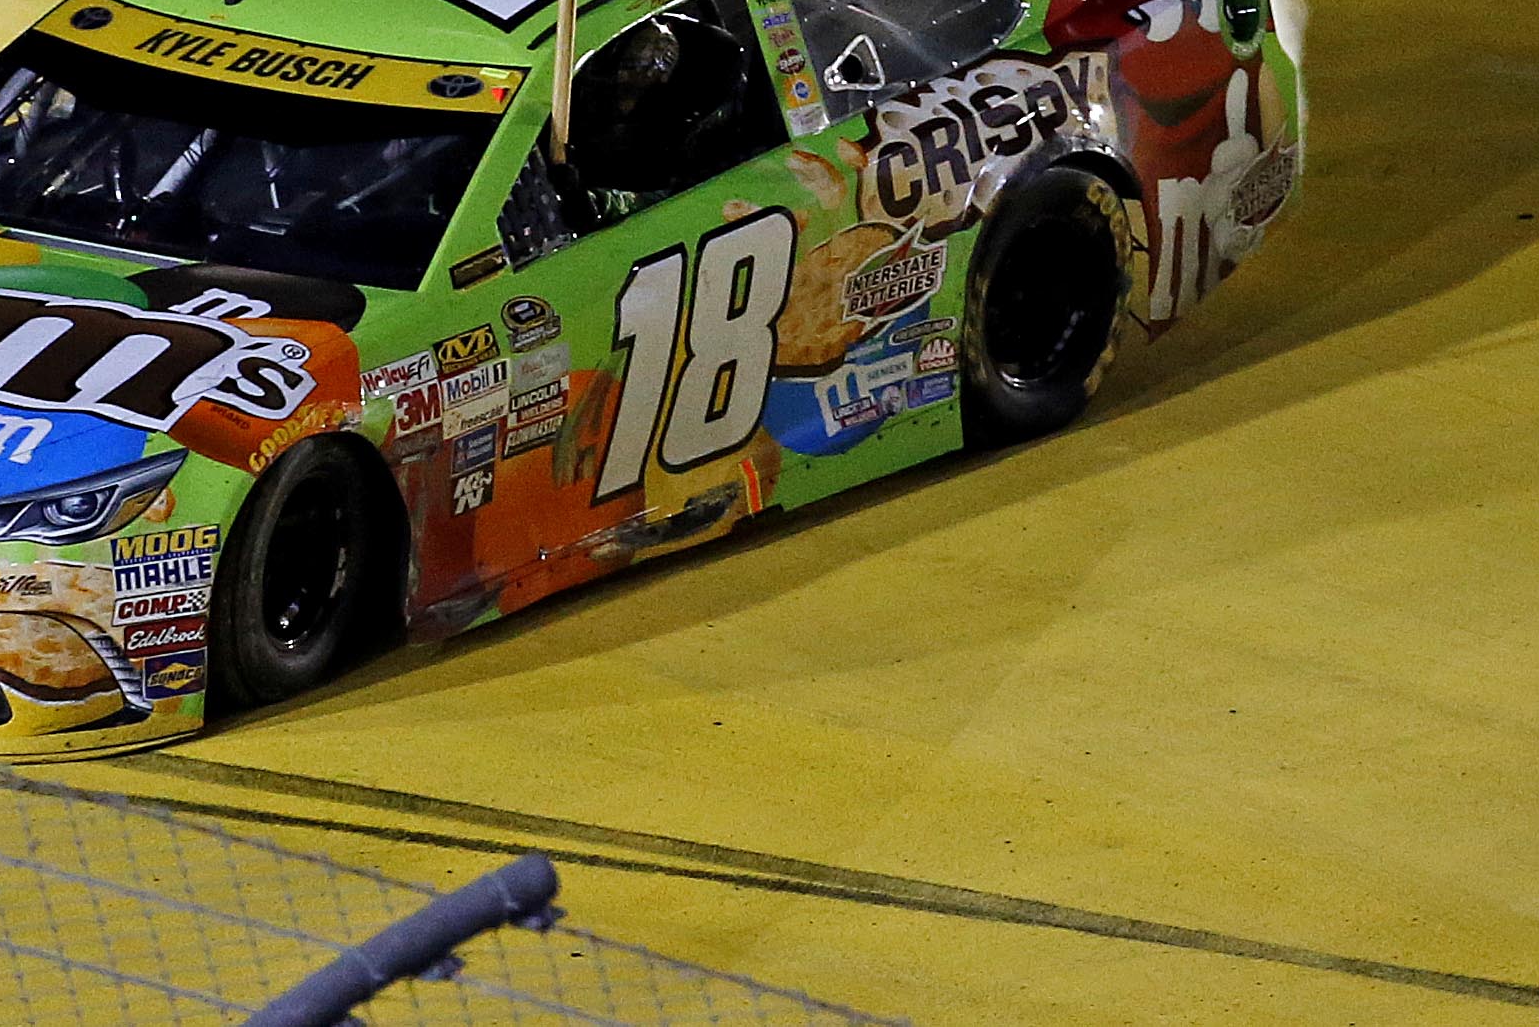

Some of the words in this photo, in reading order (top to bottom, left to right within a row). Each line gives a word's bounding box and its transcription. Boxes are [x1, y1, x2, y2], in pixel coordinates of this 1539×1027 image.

[134, 27, 237, 67] KYLE
[225, 47, 376, 91] BUSCH
[876, 55, 1091, 219] CRISPY
[846, 250, 942, 295] INTERSTATE
[849, 272, 936, 312] BATTERIES
[592, 206, 796, 505] 18
[446, 365, 490, 402] Mobil
[511, 382, 559, 411] LINCOLN
[396, 384, 442, 431] 3M
[115, 525, 219, 560] MOOG
[115, 556, 212, 592] MAHLE
[118, 593, 188, 620] COMP
[126, 624, 206, 652] Edelbrock
[147, 666, 204, 686] SUNOCO
